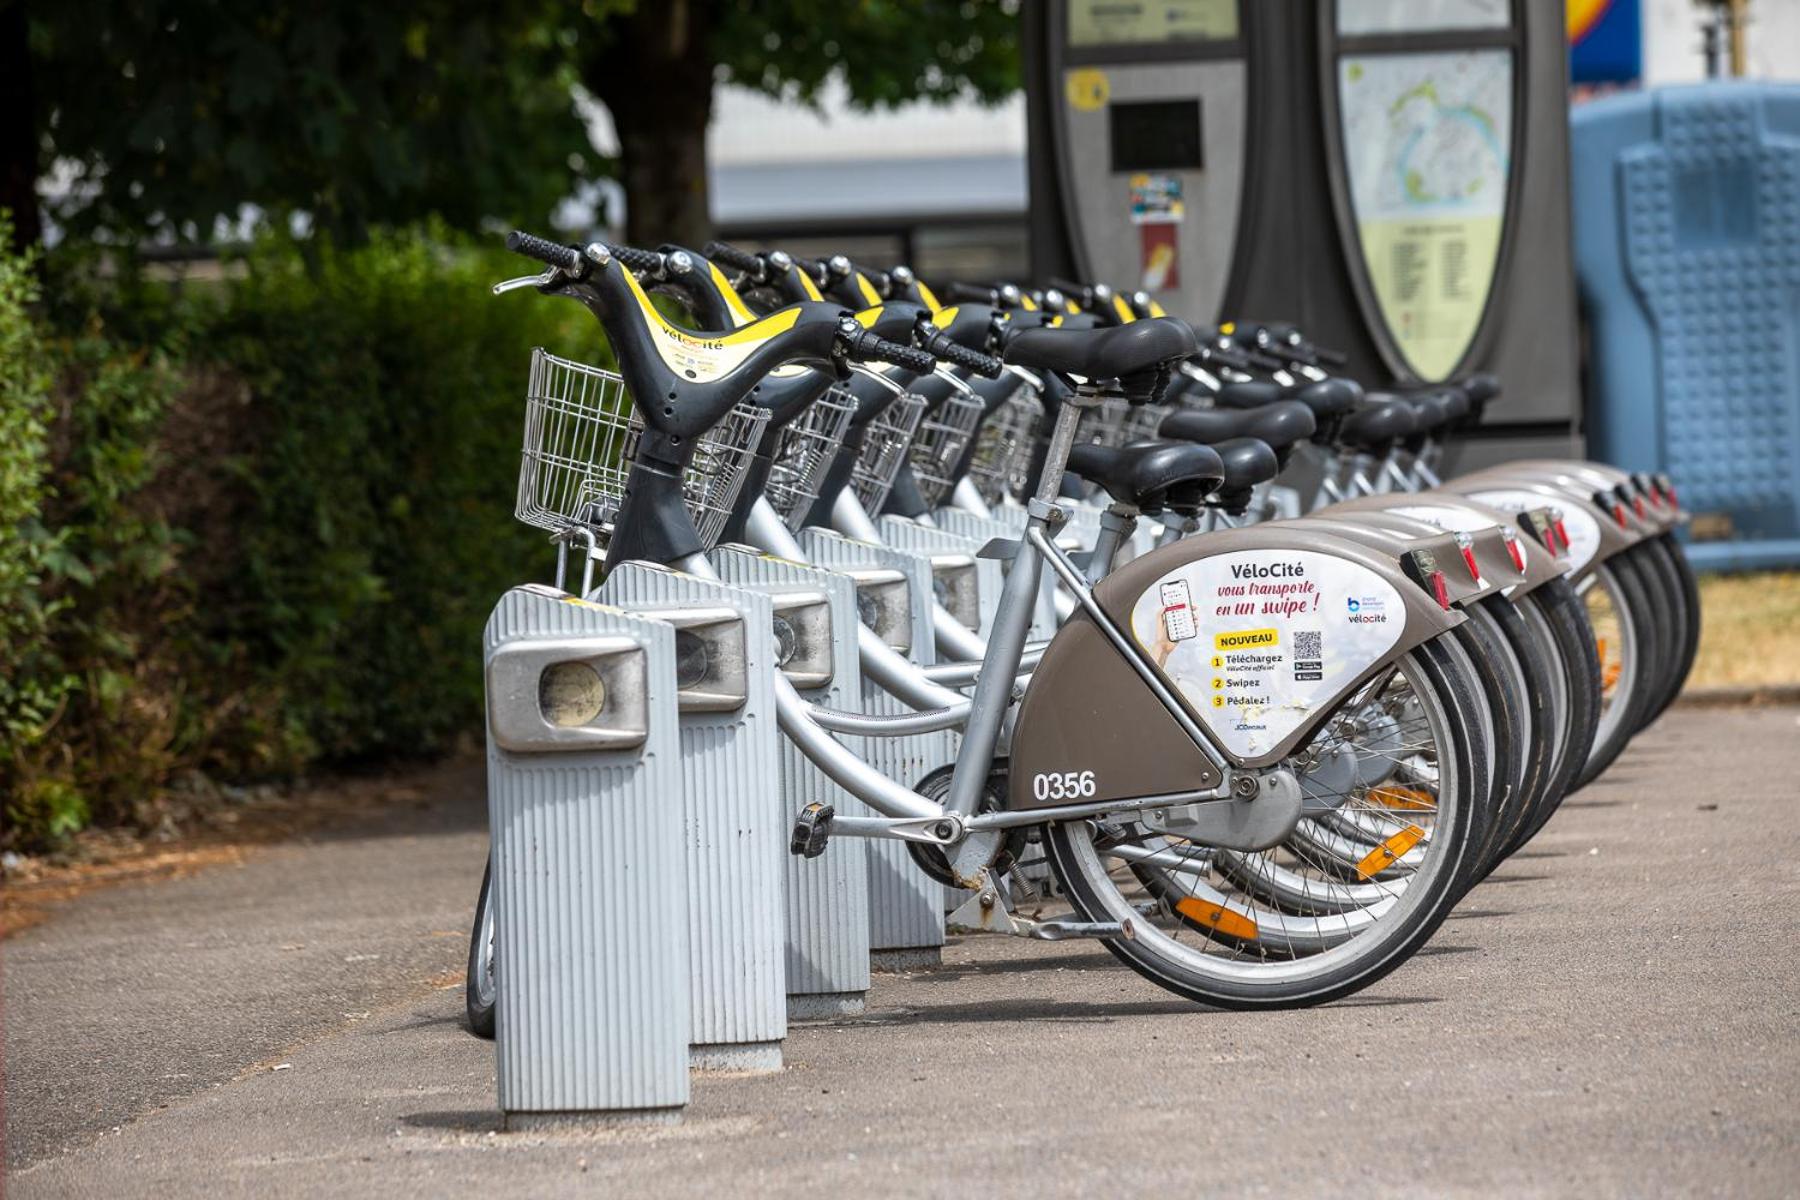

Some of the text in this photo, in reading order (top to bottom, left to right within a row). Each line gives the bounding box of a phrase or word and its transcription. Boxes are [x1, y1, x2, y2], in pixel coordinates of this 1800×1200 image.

[1231, 561, 1305, 579] VéloCité
[1217, 580, 1315, 598] vous transporte
[1216, 606, 1231, 616] en
[1234, 602, 1255, 616] un
[1261, 597, 1307, 619] swipe
[1220, 633, 1273, 647] NOUVEAU
[1226, 654, 1283, 664] Téléchargez
[1226, 678, 1260, 689] Swipez
[1033, 770, 1097, 801] 0356
